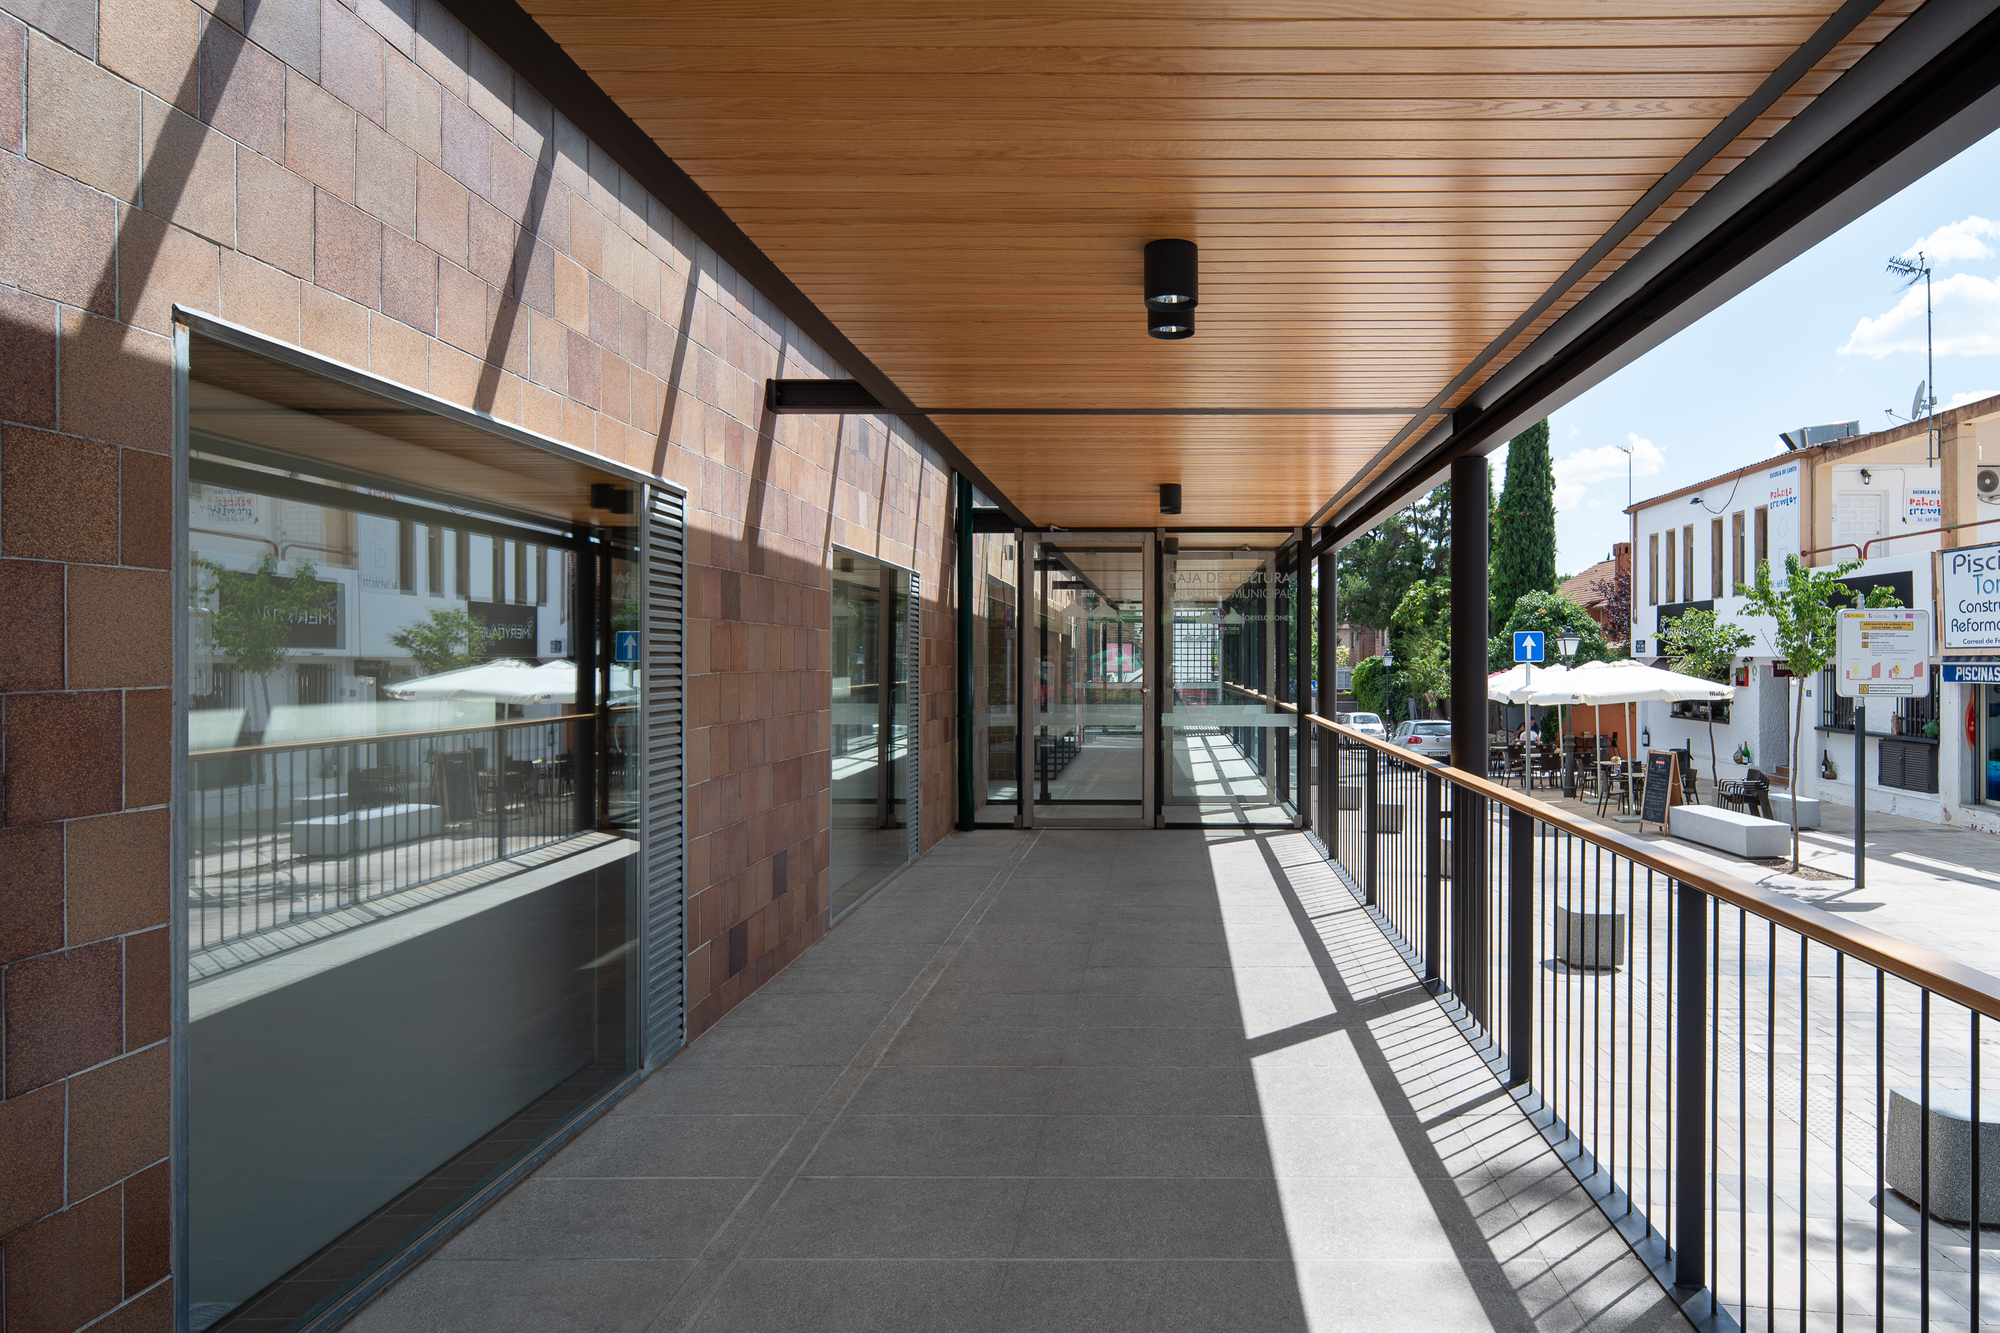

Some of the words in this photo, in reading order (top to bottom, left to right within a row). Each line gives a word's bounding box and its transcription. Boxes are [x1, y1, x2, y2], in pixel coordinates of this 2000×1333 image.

[1167, 572, 1202, 584] CAJA
[1207, 572, 1224, 584] DE
[1229, 572, 1292, 584] CULTURA
[1166, 588, 1228, 598] BIBLIOTECA
[1232, 588, 1292, 598] MUNICIPAL
[1956, 666, 2000, 681] PISCINAS
